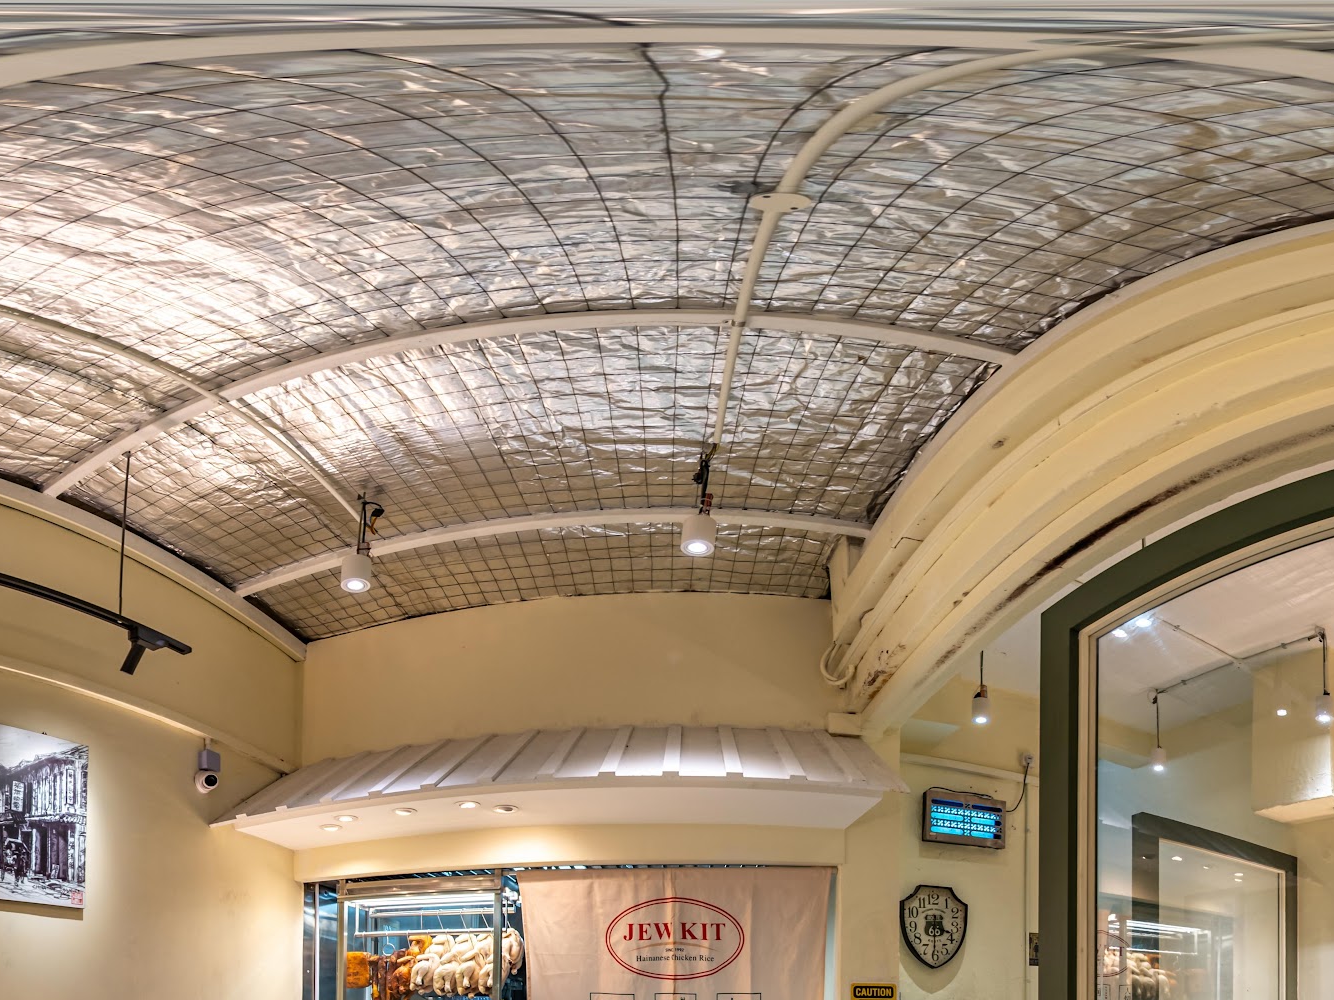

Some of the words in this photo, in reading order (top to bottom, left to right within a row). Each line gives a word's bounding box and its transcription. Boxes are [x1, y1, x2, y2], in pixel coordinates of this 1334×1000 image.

[918, 897, 926, 908] 11
[927, 893, 940, 905] 12
[945, 898, 949, 909] 1
[907, 906, 919, 918] 10
[951, 907, 959, 919] 2
[623, 922, 673, 941] JEW
[680, 922, 726, 941] KIT
[909, 921, 917, 933] 9
[928, 925, 941, 936] 66
[951, 921, 959, 934] 3
[913, 932, 922, 945] 8
[946, 933, 955, 944] 4
[922, 944, 930, 955] 7
[931, 949, 939, 961] 6
[941, 944, 949, 956] 5
[636, 954, 671, 962] Hainanese
[671, 954, 697, 962] Chicken
[699, 954, 715, 962] Rice
[855, 988, 892, 997] CAUTION
